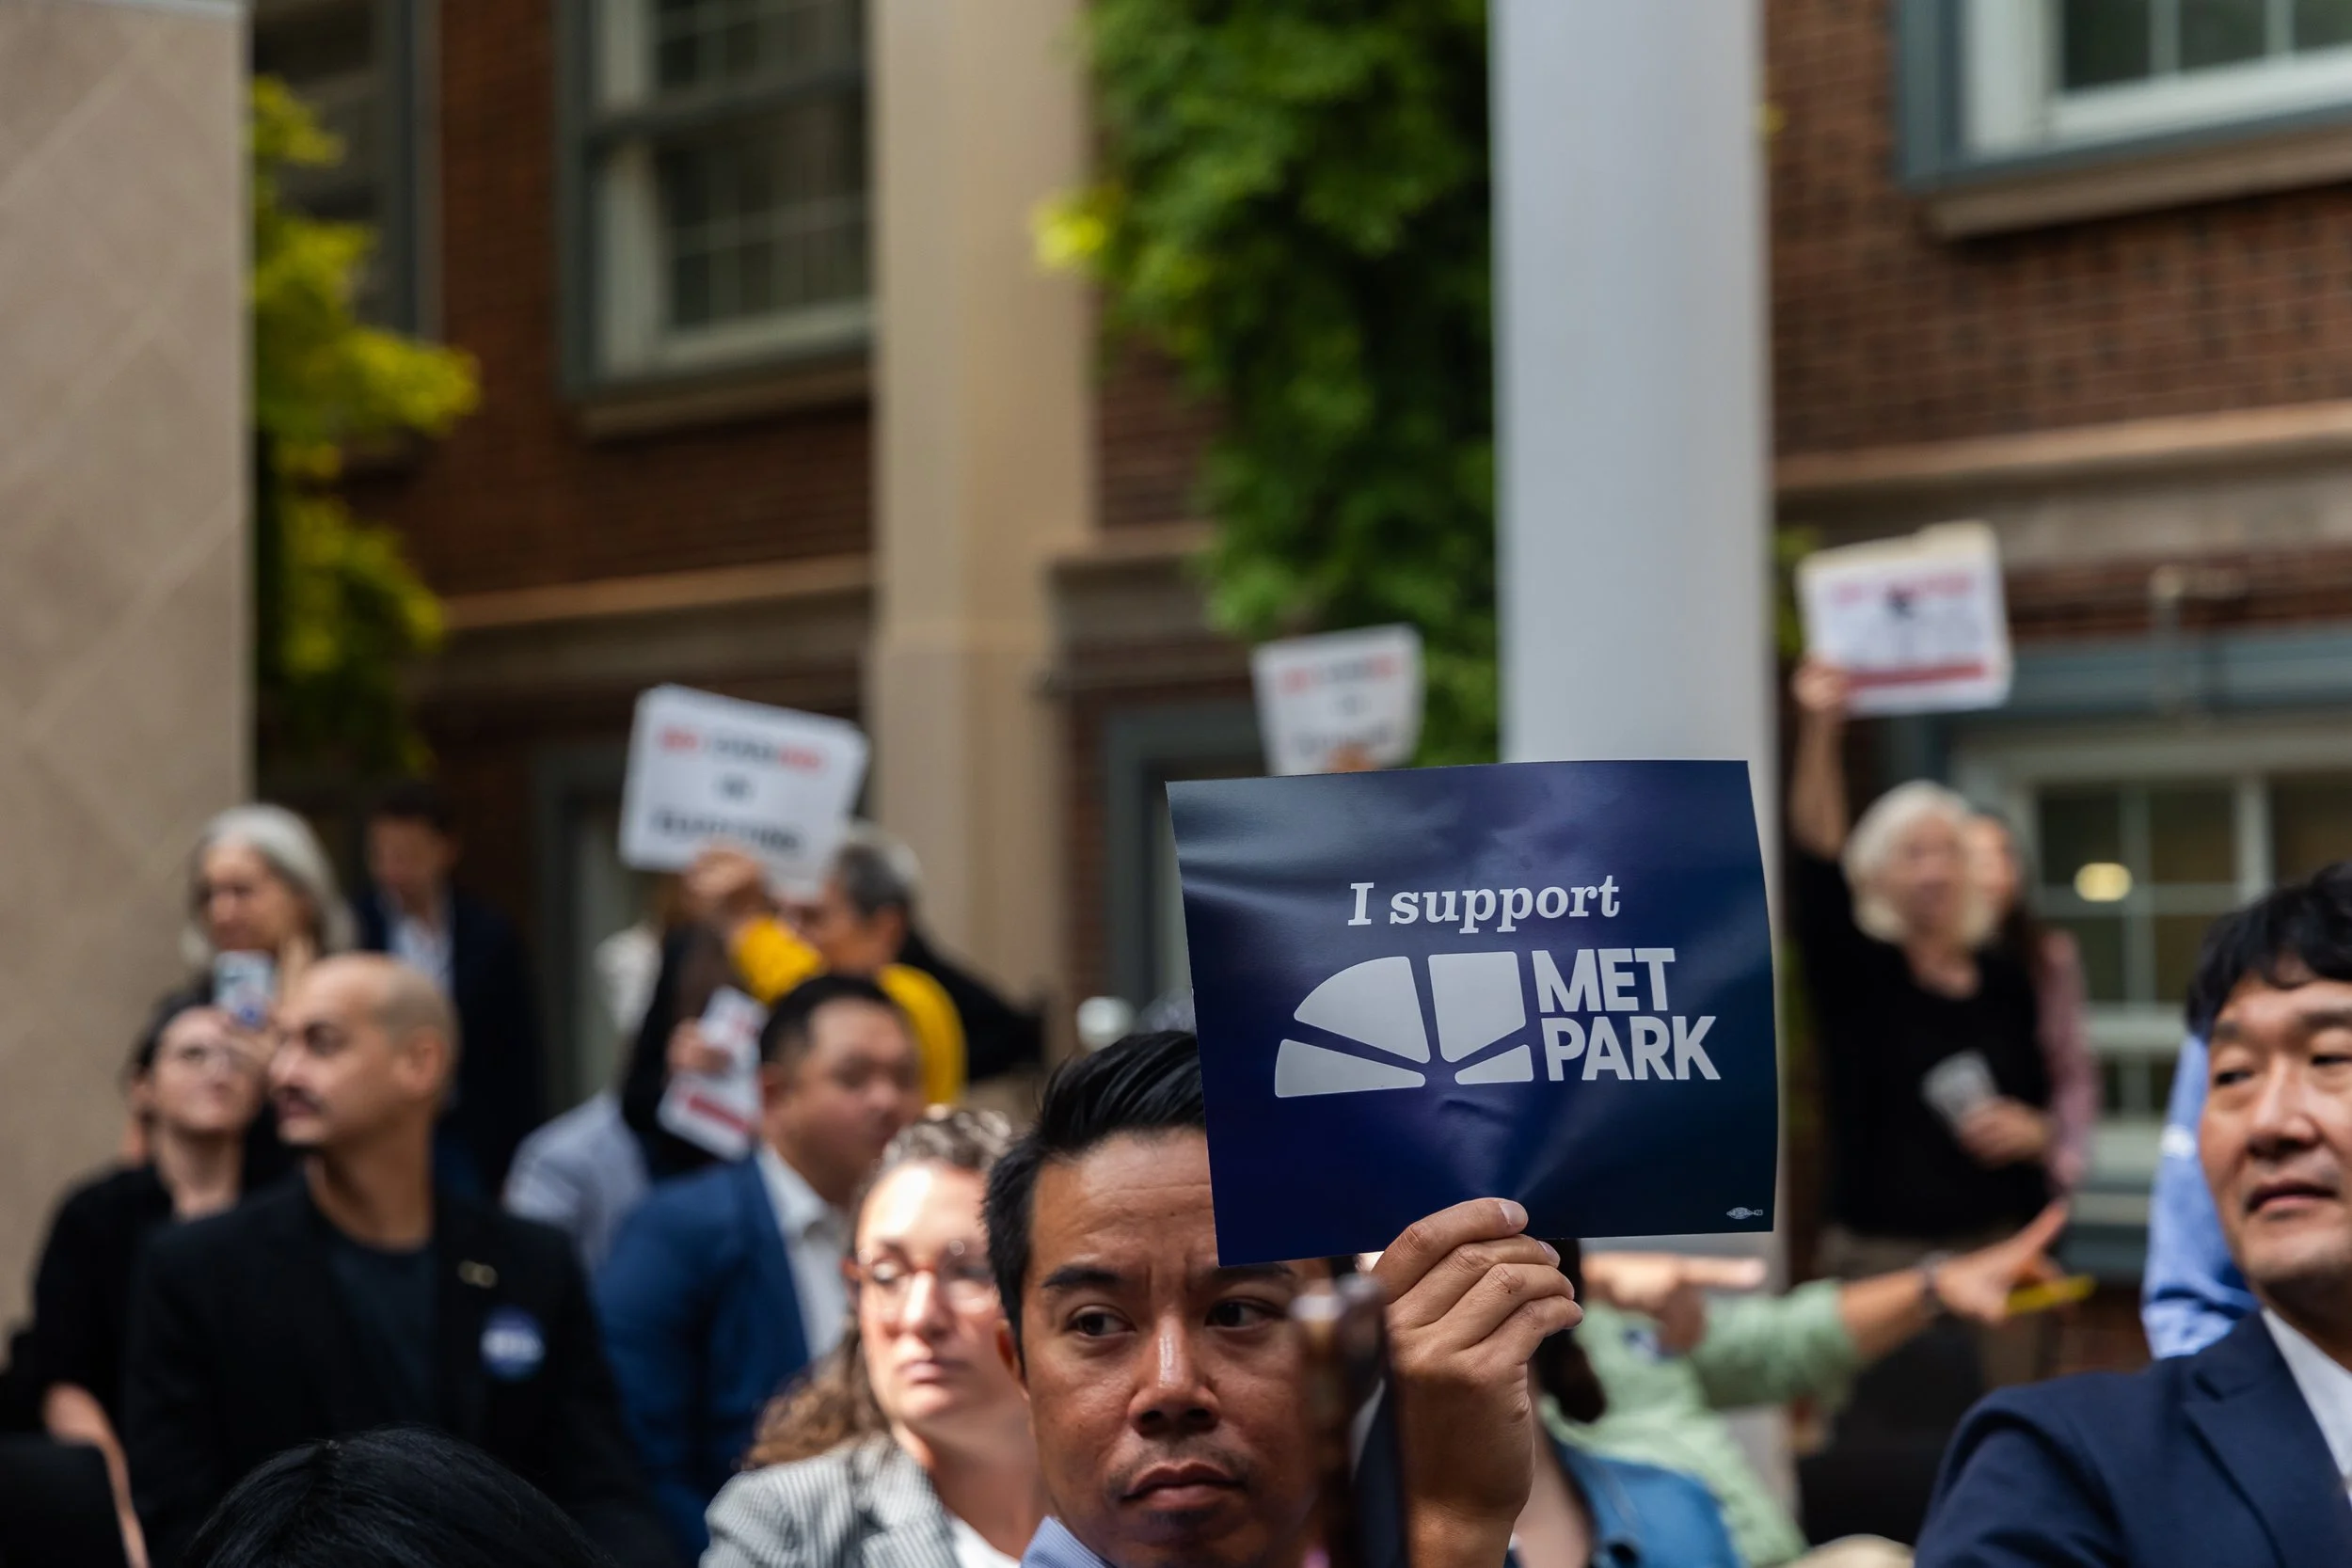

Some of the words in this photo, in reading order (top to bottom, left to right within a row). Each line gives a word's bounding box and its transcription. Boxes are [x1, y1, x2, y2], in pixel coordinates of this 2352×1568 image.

[1347, 882, 1375, 927] I
[1389, 875, 1621, 934] support
[1531, 947, 1676, 1013] MET
[1540, 1015, 1723, 1083] PARK
